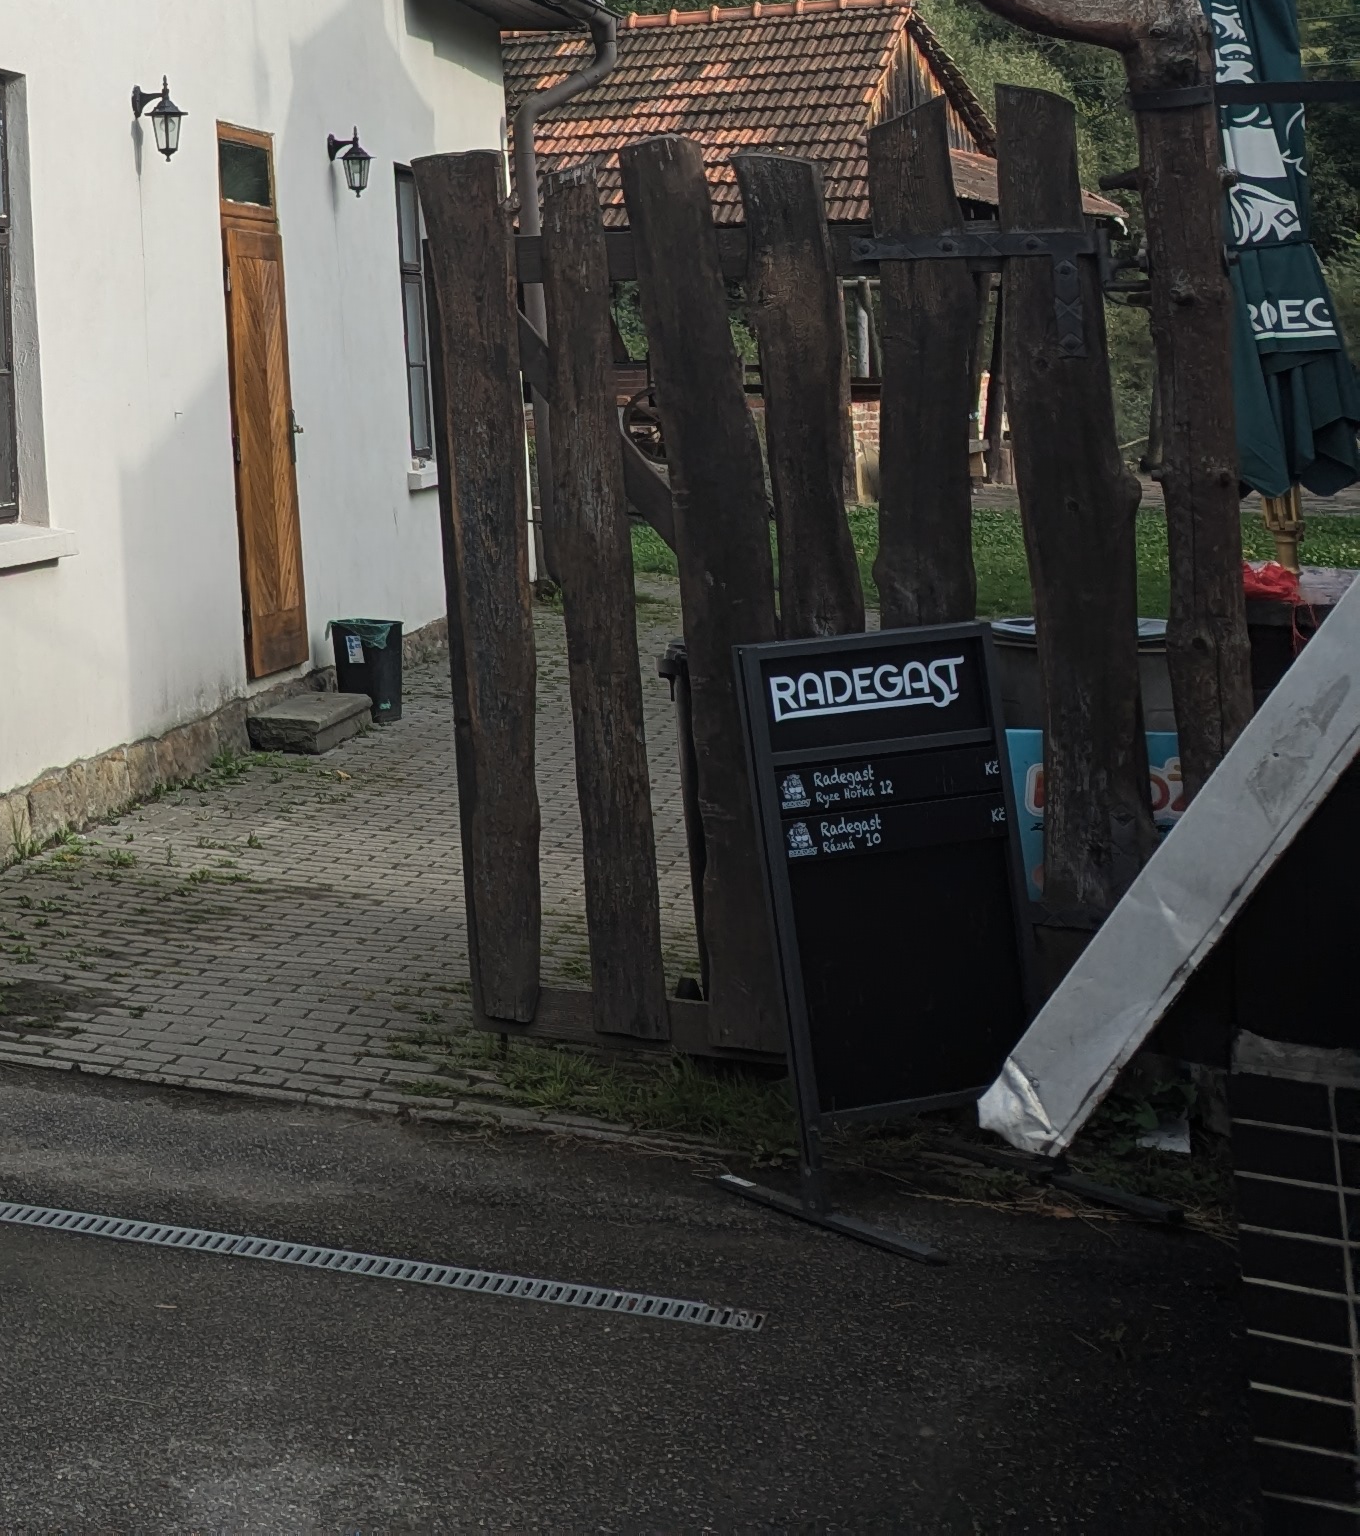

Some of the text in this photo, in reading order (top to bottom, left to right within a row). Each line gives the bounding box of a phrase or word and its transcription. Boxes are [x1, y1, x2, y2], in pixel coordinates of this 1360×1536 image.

[770, 655, 965, 722] RADEGAST
[813, 760, 1000, 788] Radegast Kč
[815, 780, 894, 809] Ryze Hořká 12
[820, 807, 1006, 838] Radegast Kč
[822, 832, 882, 854] Rázná 10
